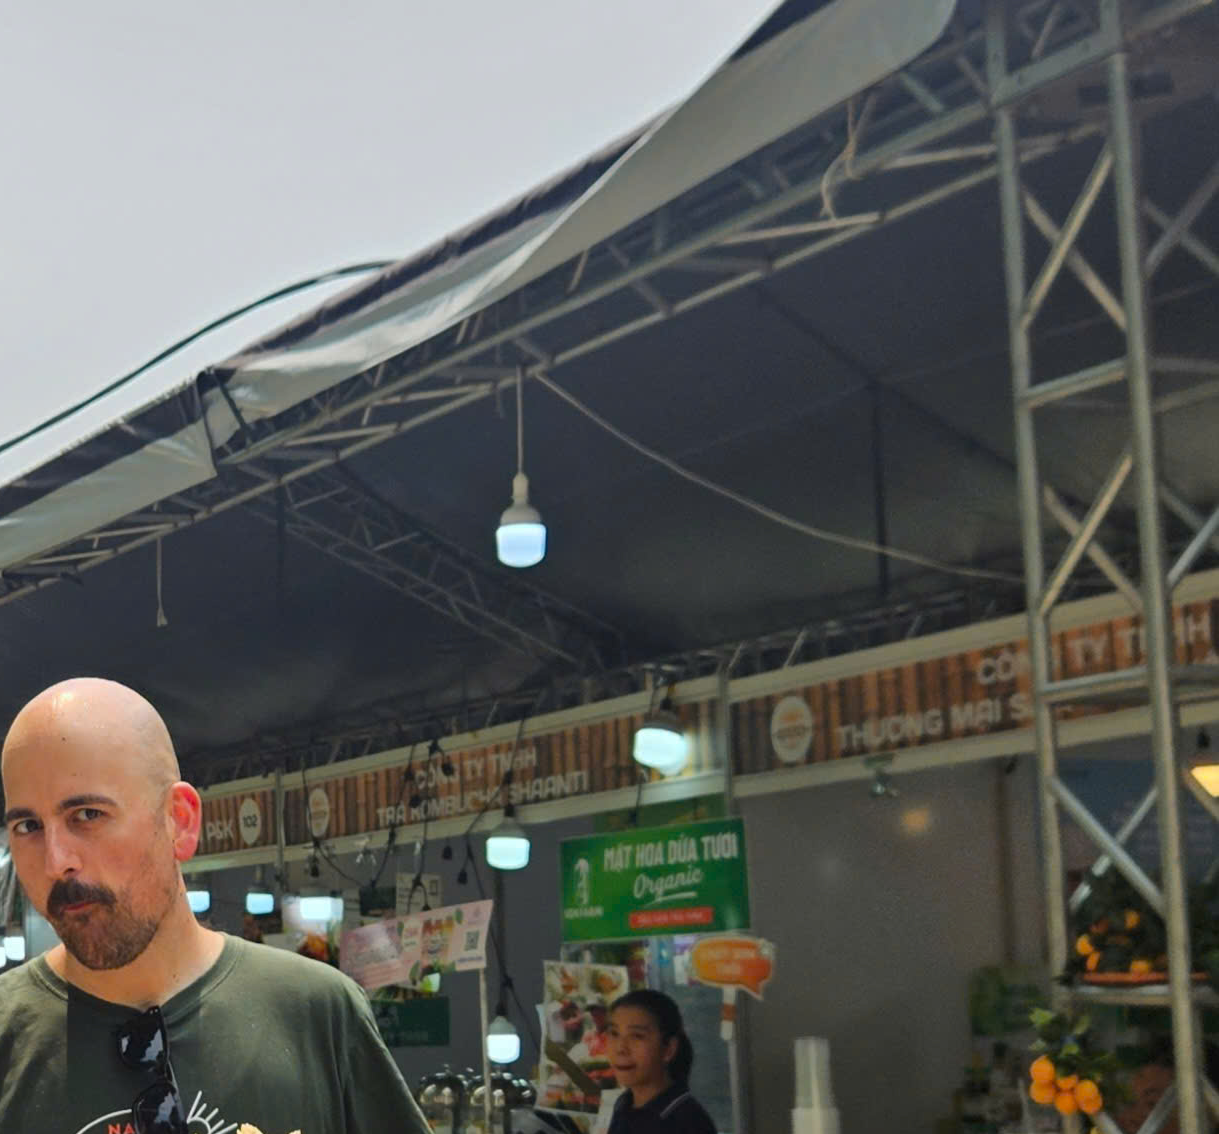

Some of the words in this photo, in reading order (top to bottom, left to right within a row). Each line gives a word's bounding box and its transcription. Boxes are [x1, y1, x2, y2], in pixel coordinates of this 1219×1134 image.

[242, 814, 258, 828] 102
[635, 841, 665, 868] HOA
[633, 863, 706, 900] Organic
